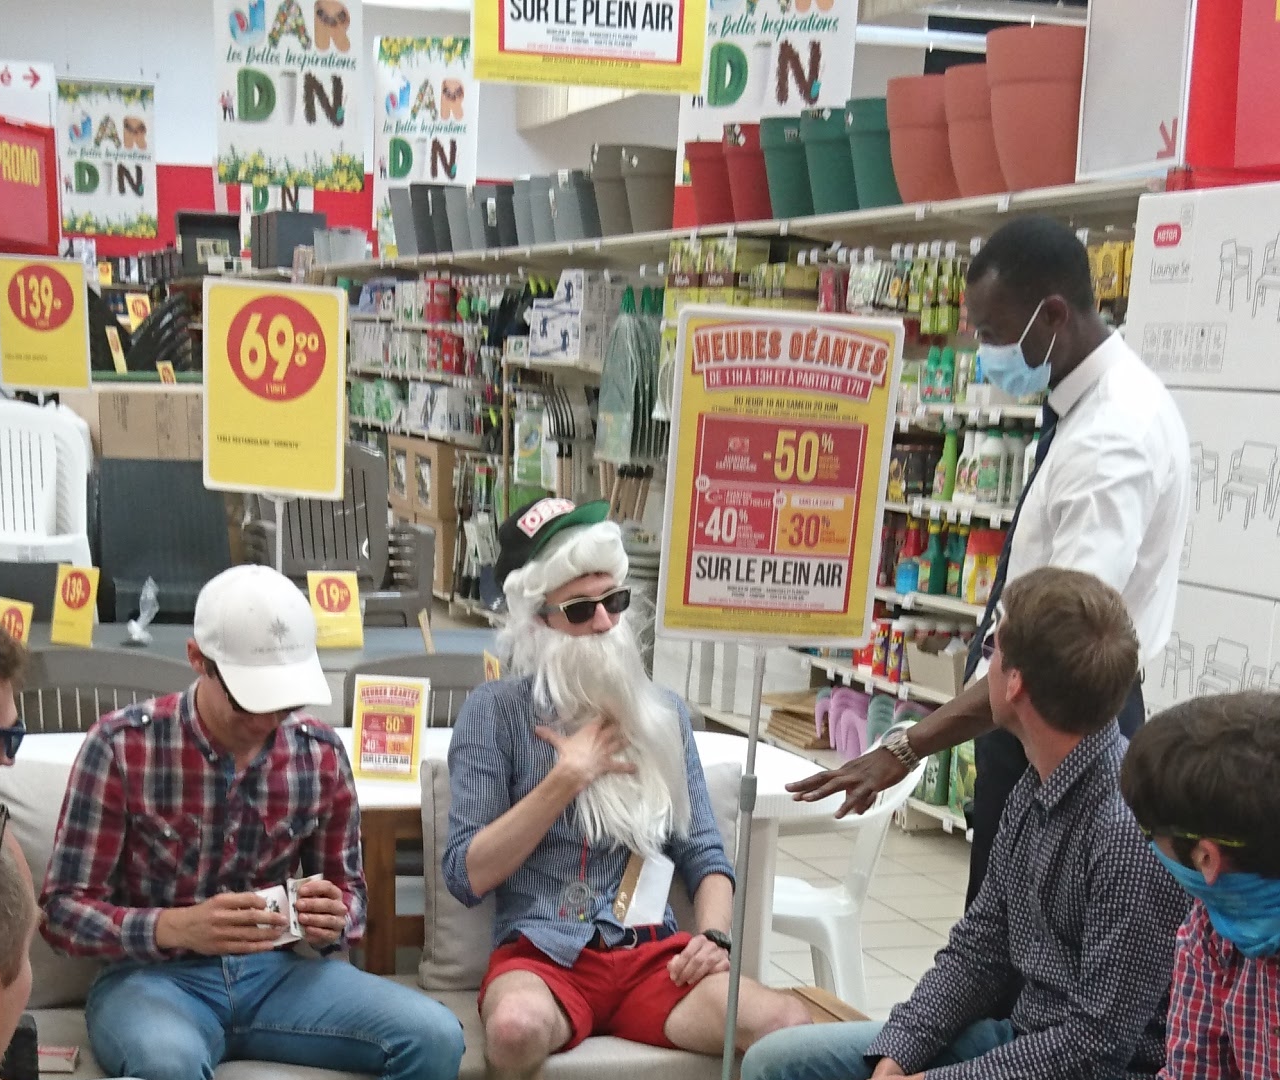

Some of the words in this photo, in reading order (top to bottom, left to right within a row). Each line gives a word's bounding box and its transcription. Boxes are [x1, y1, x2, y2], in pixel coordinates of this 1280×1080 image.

[228, 0, 351, 52] JAR
[510, 0, 552, 22] SUR
[554, 0, 580, 24] LE
[582, 0, 639, 29] PLEIN
[641, 2, 674, 32] AIR
[719, 15, 756, 38] Belles
[760, 13, 840, 41] Inspirations
[245, 47, 281, 66] Belles
[284, 50, 357, 71] Inspirations
[707, 40, 822, 108] DIN
[237, 66, 346, 127] DIN
[385, 75, 465, 121] JAR
[69, 108, 147, 150] JAR
[388, 137, 458, 180] DIN
[1153, 260, 1180, 281] Lounge
[694, 328, 782, 364] HEURES
[789, 325, 889, 376] GÉANTES
[709, 370, 720, 384] DE
[755, 369, 772, 384] 13H
[773, 370, 785, 385] ET
[796, 374, 829, 389] PARTIR
[831, 376, 844, 390] DE
[845, 378, 864, 395] 17H
[763, 429, 834, 483] -50%
[697, 506, 748, 544] -40%
[781, 512, 830, 548] -30%
[695, 555, 732, 581] SUR
[735, 558, 757, 583] LE
[760, 559, 811, 586] PLEIN
[814, 562, 843, 587] AIR
